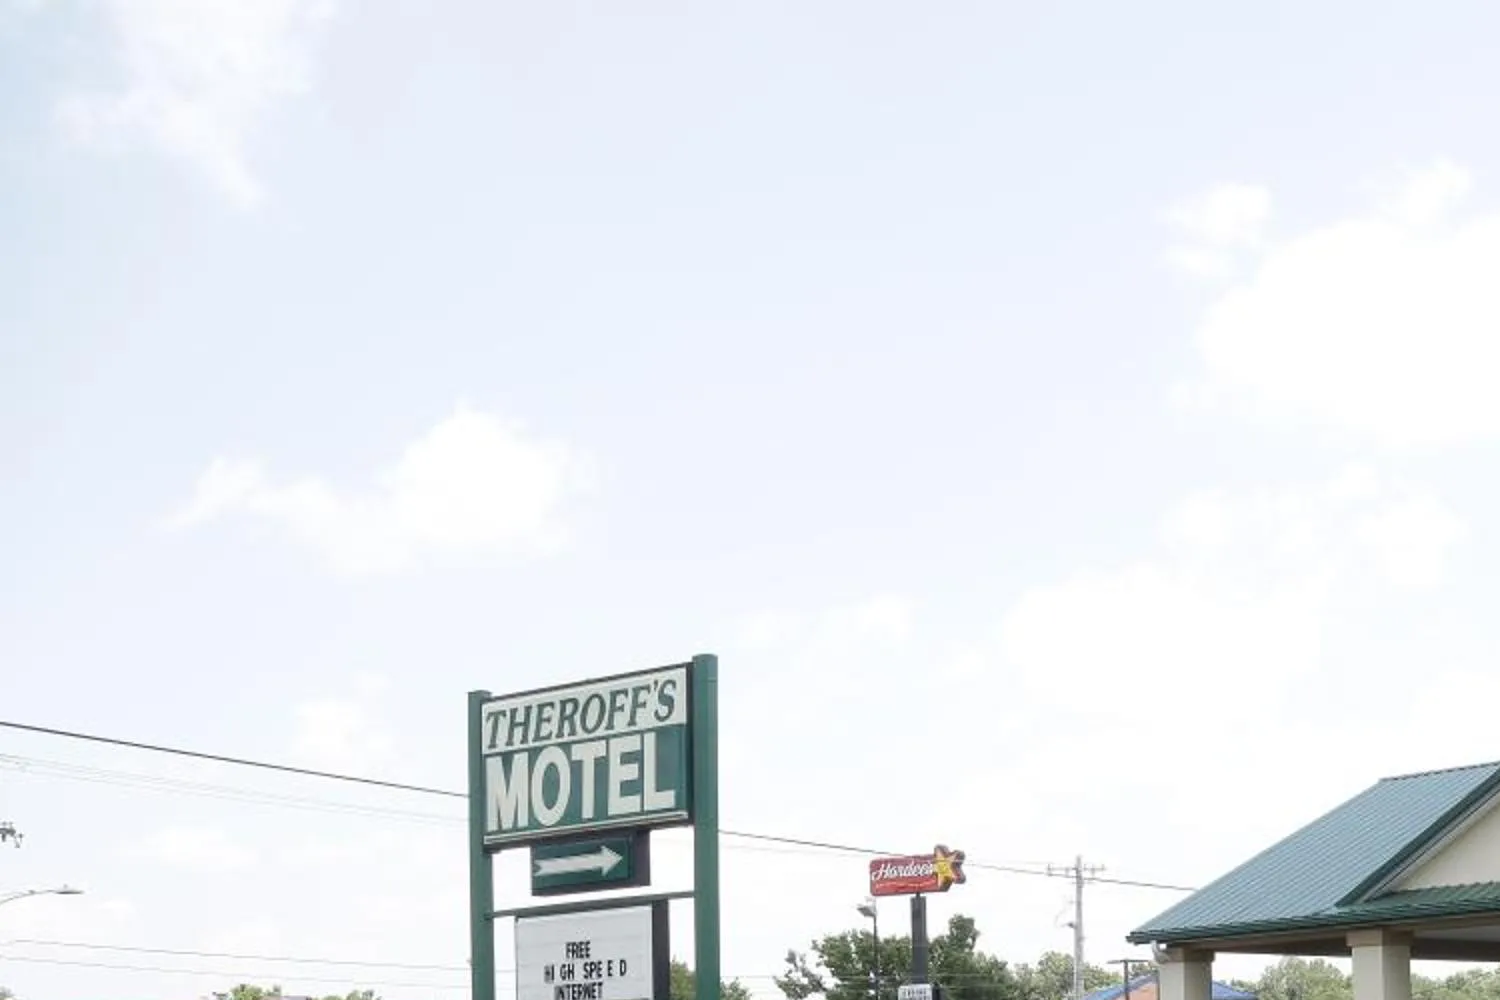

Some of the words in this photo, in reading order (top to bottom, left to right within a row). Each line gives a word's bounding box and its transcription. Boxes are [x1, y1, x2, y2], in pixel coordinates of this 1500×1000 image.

[485, 679, 677, 750] THEROFF'S
[485, 731, 676, 832] MOTEL
[543, 963, 575, 984] HIGH
[583, 959, 627, 979] SPEED
[565, 940, 591, 959] FREE
